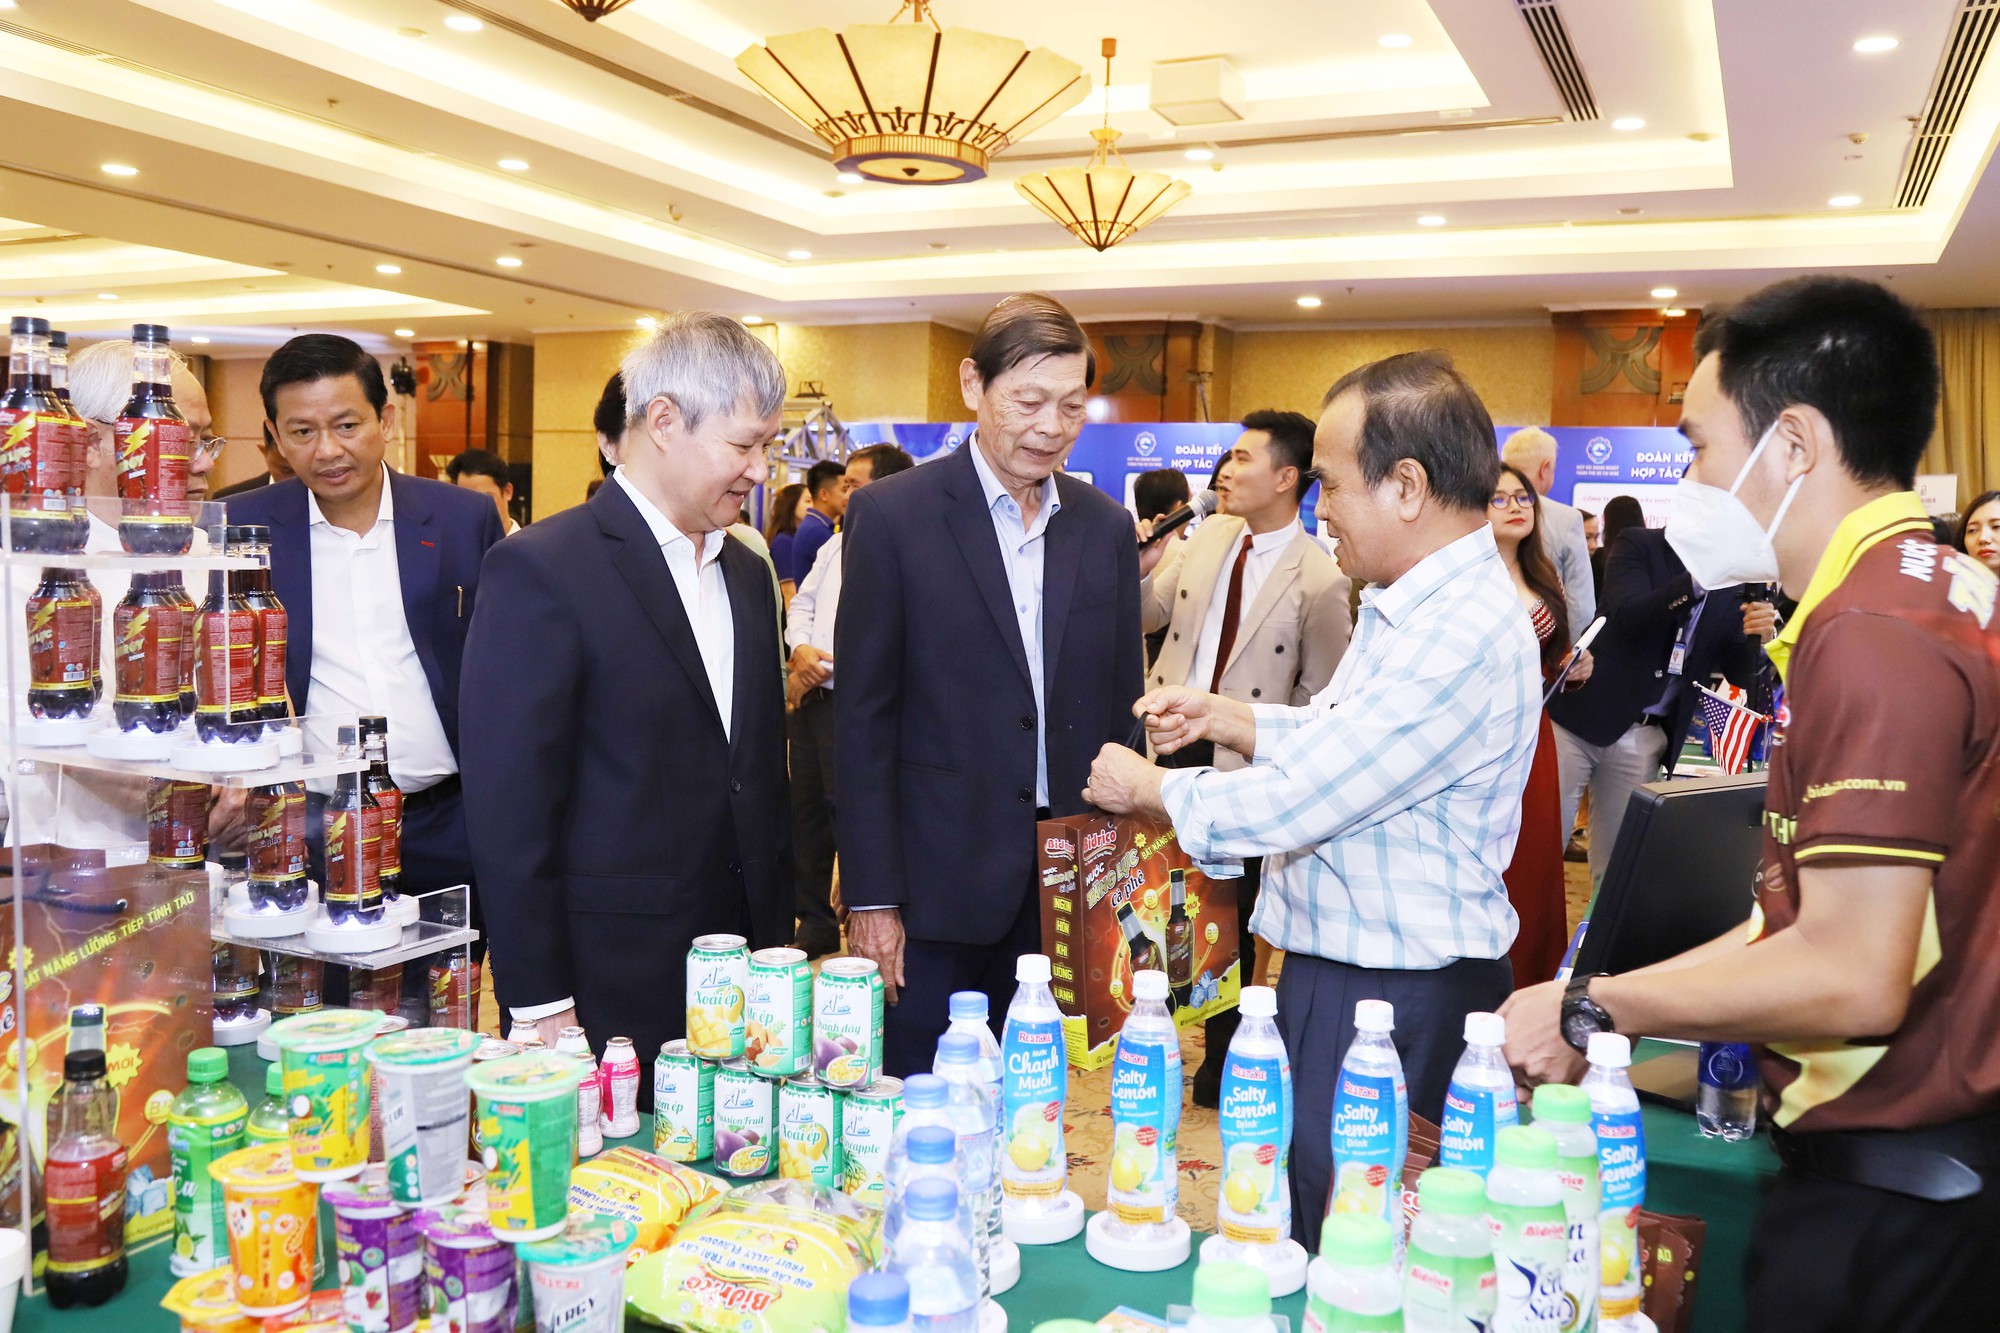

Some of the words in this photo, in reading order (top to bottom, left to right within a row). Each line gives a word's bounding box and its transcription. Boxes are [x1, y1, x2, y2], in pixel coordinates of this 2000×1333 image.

[1175, 444, 1204, 456] ĐOÀN
[1636, 450, 1671, 463] ĐOÀN
[1675, 449, 1694, 463] KẾT
[1171, 458, 1192, 470] HỢP
[1194, 458, 1213, 469] TÁC
[1631, 467, 1656, 480] HỢP
[1659, 466, 1682, 479] TÁC
[1083, 829, 1117, 852] Bidrico
[1086, 862, 1105, 887] NƯỚC
[1086, 870, 1117, 910] TĂNG
[1116, 848, 1140, 882] LỰC
[1053, 898, 1072, 912] NGON
[1056, 943, 1068, 956] KHI
[693, 991, 723, 1006] Xoài
[724, 992, 739, 1008] ép
[759, 1008, 774, 1027] ép
[1018, 1032, 1053, 1044] RESTORE
[1009, 1045, 1059, 1075] Chanh
[1118, 1069, 1148, 1089] Salty
[1111, 1077, 1157, 1101] Lemon
[1233, 1086, 1267, 1105] Salty
[672, 1101, 684, 1115] ép
[1222, 1095, 1277, 1119] Lemon
[1343, 1103, 1379, 1124] Salty
[1333, 1113, 1389, 1138] Lemon
[1445, 1115, 1474, 1137] Salty
[807, 1128, 821, 1147] ép
[1601, 1144, 1638, 1166] Salty
[1602, 1158, 1646, 1184] emon
[699, 1234, 743, 1255] FLAVOUR
[745, 1249, 774, 1264] JELLY
[776, 1257, 805, 1273] FRUIT
[684, 1275, 772, 1313] Bidrico
